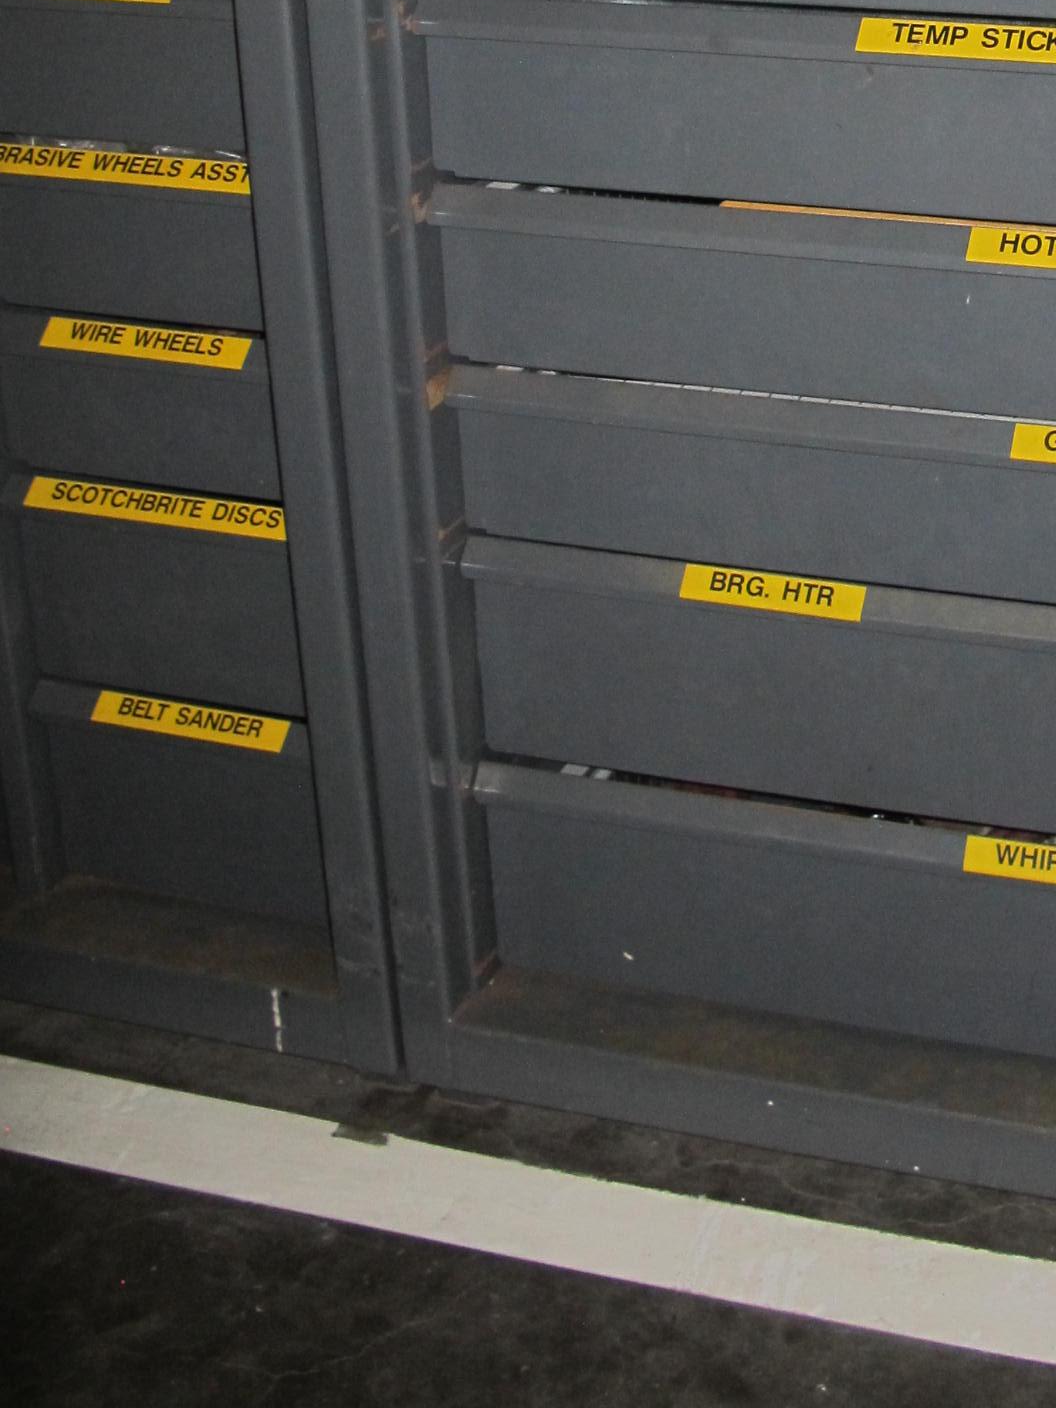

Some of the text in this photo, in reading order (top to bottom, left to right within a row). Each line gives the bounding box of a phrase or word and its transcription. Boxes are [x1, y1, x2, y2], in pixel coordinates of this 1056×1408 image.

[892, 22, 968, 46] TEMP
[93, 153, 183, 178] WHEELS
[70, 321, 224, 356] WIRE WHEELS
[51, 481, 282, 529] SCOTCHBRITE DISCS
[709, 571, 835, 607] BRG. HTR
[118, 697, 263, 738] BELT SANDER
